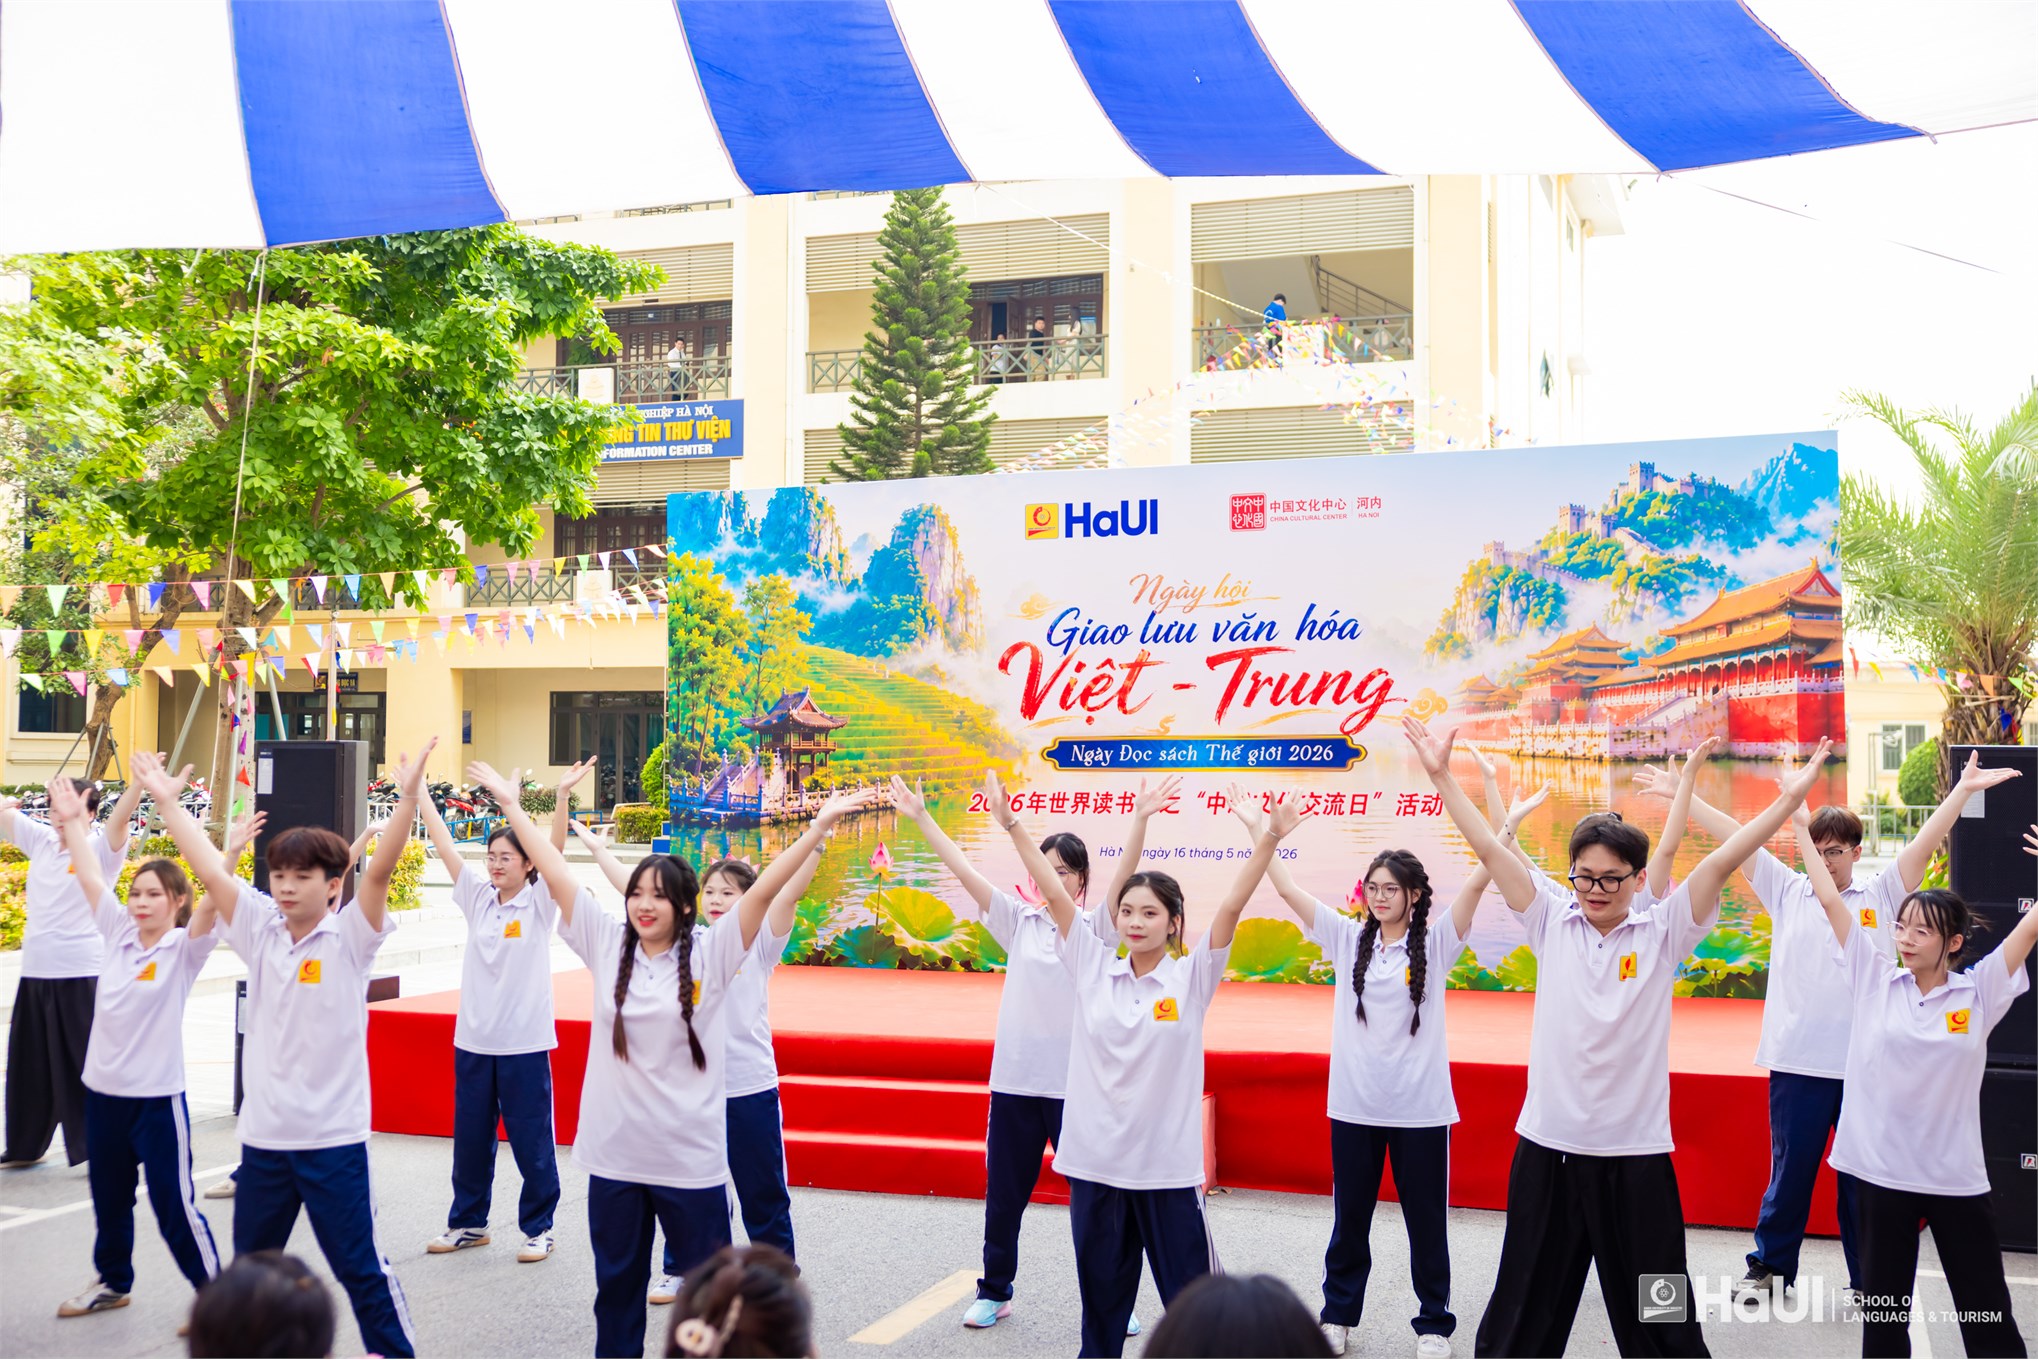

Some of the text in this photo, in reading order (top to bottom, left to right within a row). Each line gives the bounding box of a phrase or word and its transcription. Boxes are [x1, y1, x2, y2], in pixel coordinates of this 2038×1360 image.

[642, 404, 713, 419] GHIỆP HÀ NỘI
[637, 423, 661, 442] TIN
[664, 419, 694, 441] THƯ
[695, 415, 731, 442] VIỆN
[602, 444, 713, 459] FORMATION CENTER
[1269, 495, 1382, 513] 中国文化中心 河内
[1064, 498, 1159, 538] HaUI
[1289, 514, 1321, 522] CULTURAL
[1322, 513, 1348, 521] CENTER
[1129, 572, 1252, 614] Ngày hội
[1046, 602, 1364, 656] Giao lưu văn hóa
[997, 640, 1170, 726] Việt
[1205, 646, 1408, 737] Trung
[1071, 743, 1334, 767] Ngày Đọc sách Thế giới 2026
[968, 790, 1182, 816] 26年世界读书之
[1395, 792, 1443, 817] 活动
[1099, 846, 1115, 857] Hà
[1142, 847, 1171, 859] ngày
[1173, 847, 1186, 858] 16
[1189, 847, 1223, 861] tháng
[1226, 848, 1234, 859] 5
[1237, 847, 1252, 859] nă
[1275, 848, 1299, 860] 26
